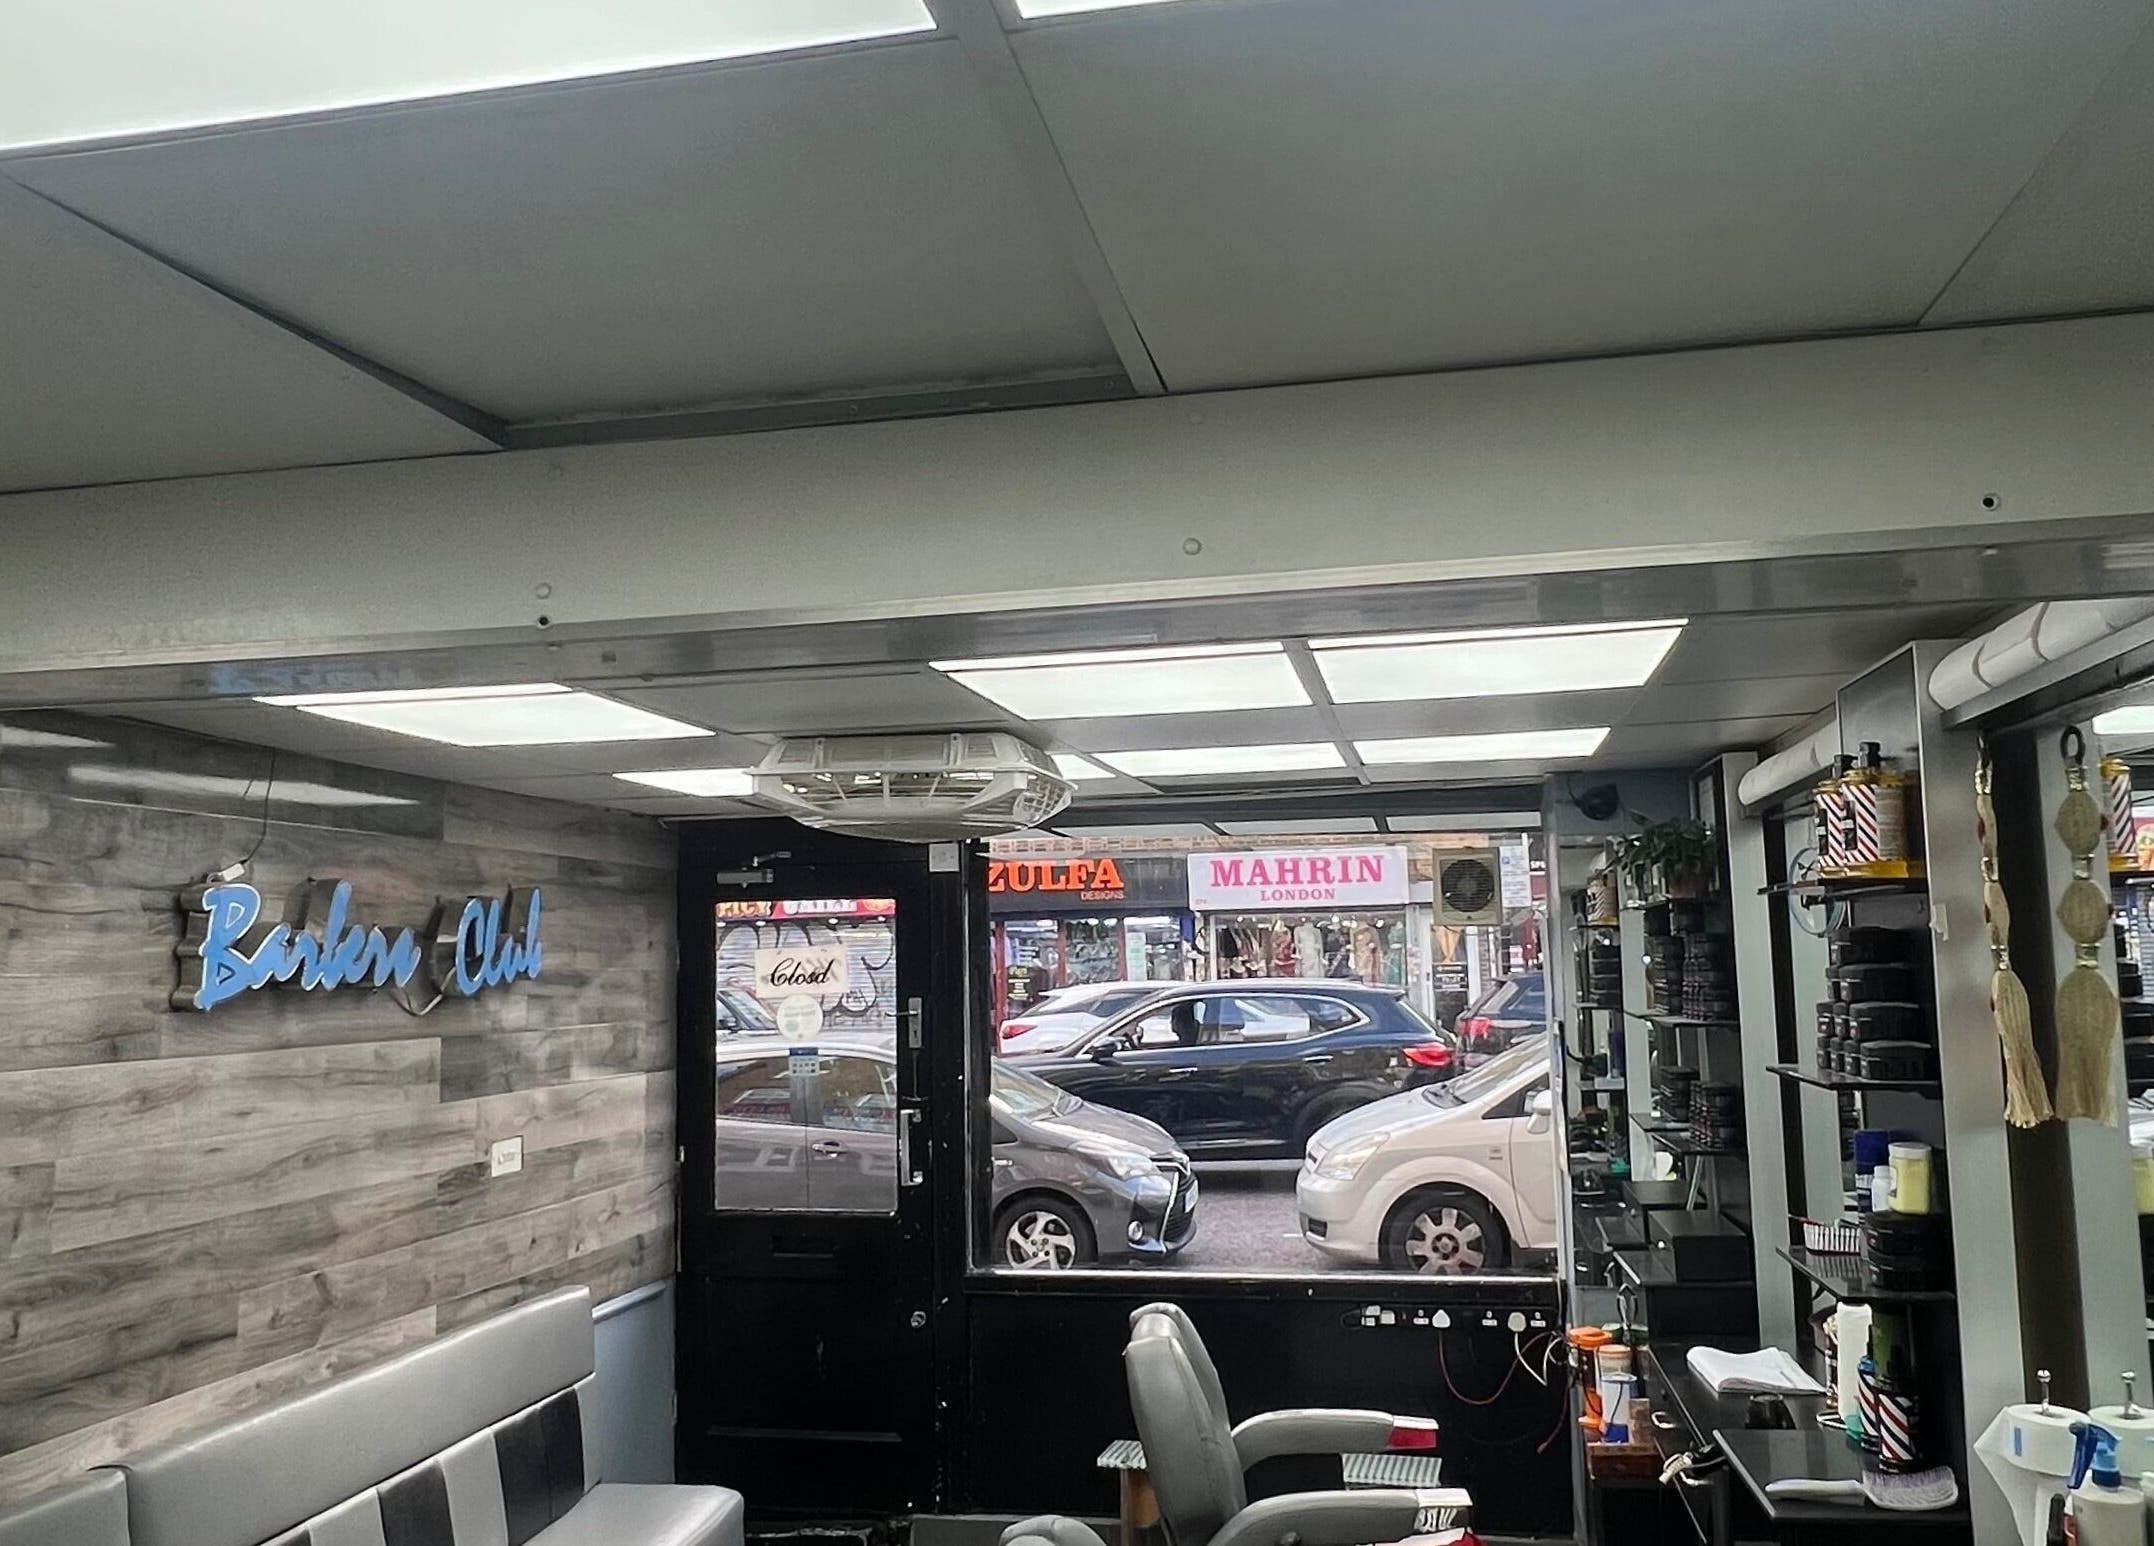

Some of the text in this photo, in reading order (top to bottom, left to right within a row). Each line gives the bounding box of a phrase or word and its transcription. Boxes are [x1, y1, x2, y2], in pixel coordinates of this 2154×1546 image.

[989, 859, 1125, 892] ZULFA
[1210, 855, 1384, 887] MAHRIN
[1081, 891, 1125, 900] DESIGNS
[1260, 888, 1336, 901] LONDON
[456, 888, 542, 996] Club
